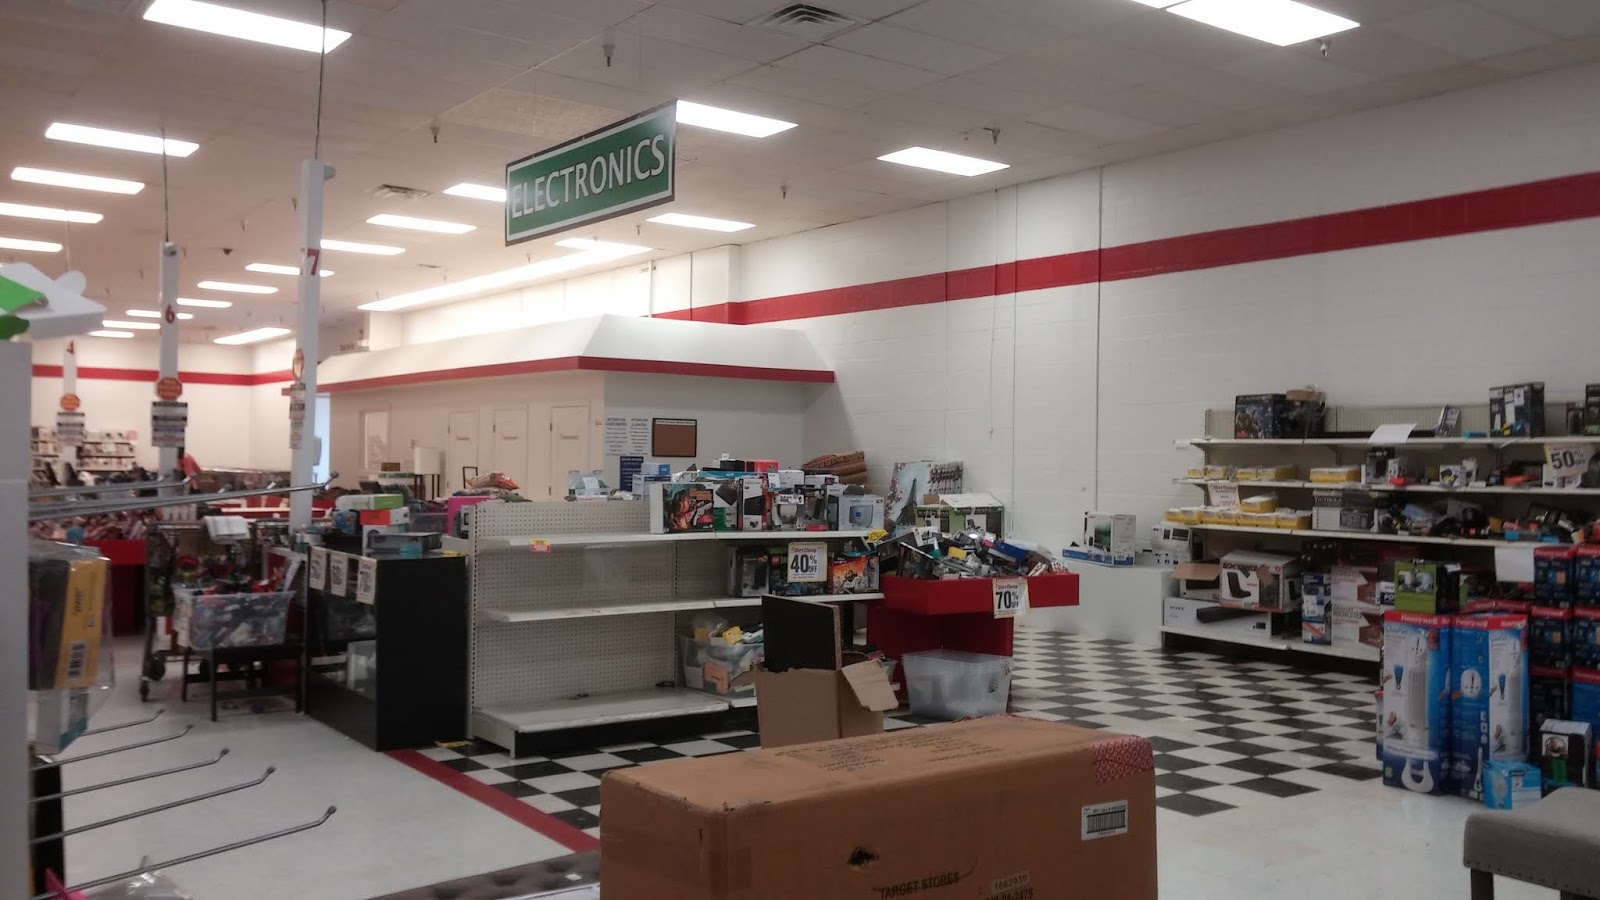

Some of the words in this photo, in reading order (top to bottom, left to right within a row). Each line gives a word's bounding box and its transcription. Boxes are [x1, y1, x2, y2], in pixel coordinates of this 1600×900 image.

[512, 134, 665, 219] ELECTRONICS
[307, 248, 320, 275] 7
[165, 305, 175, 324] 6
[1401, 614, 1438, 625] Honeywell
[881, 880, 920, 900] TARGET
[921, 872, 960, 890] STORES
